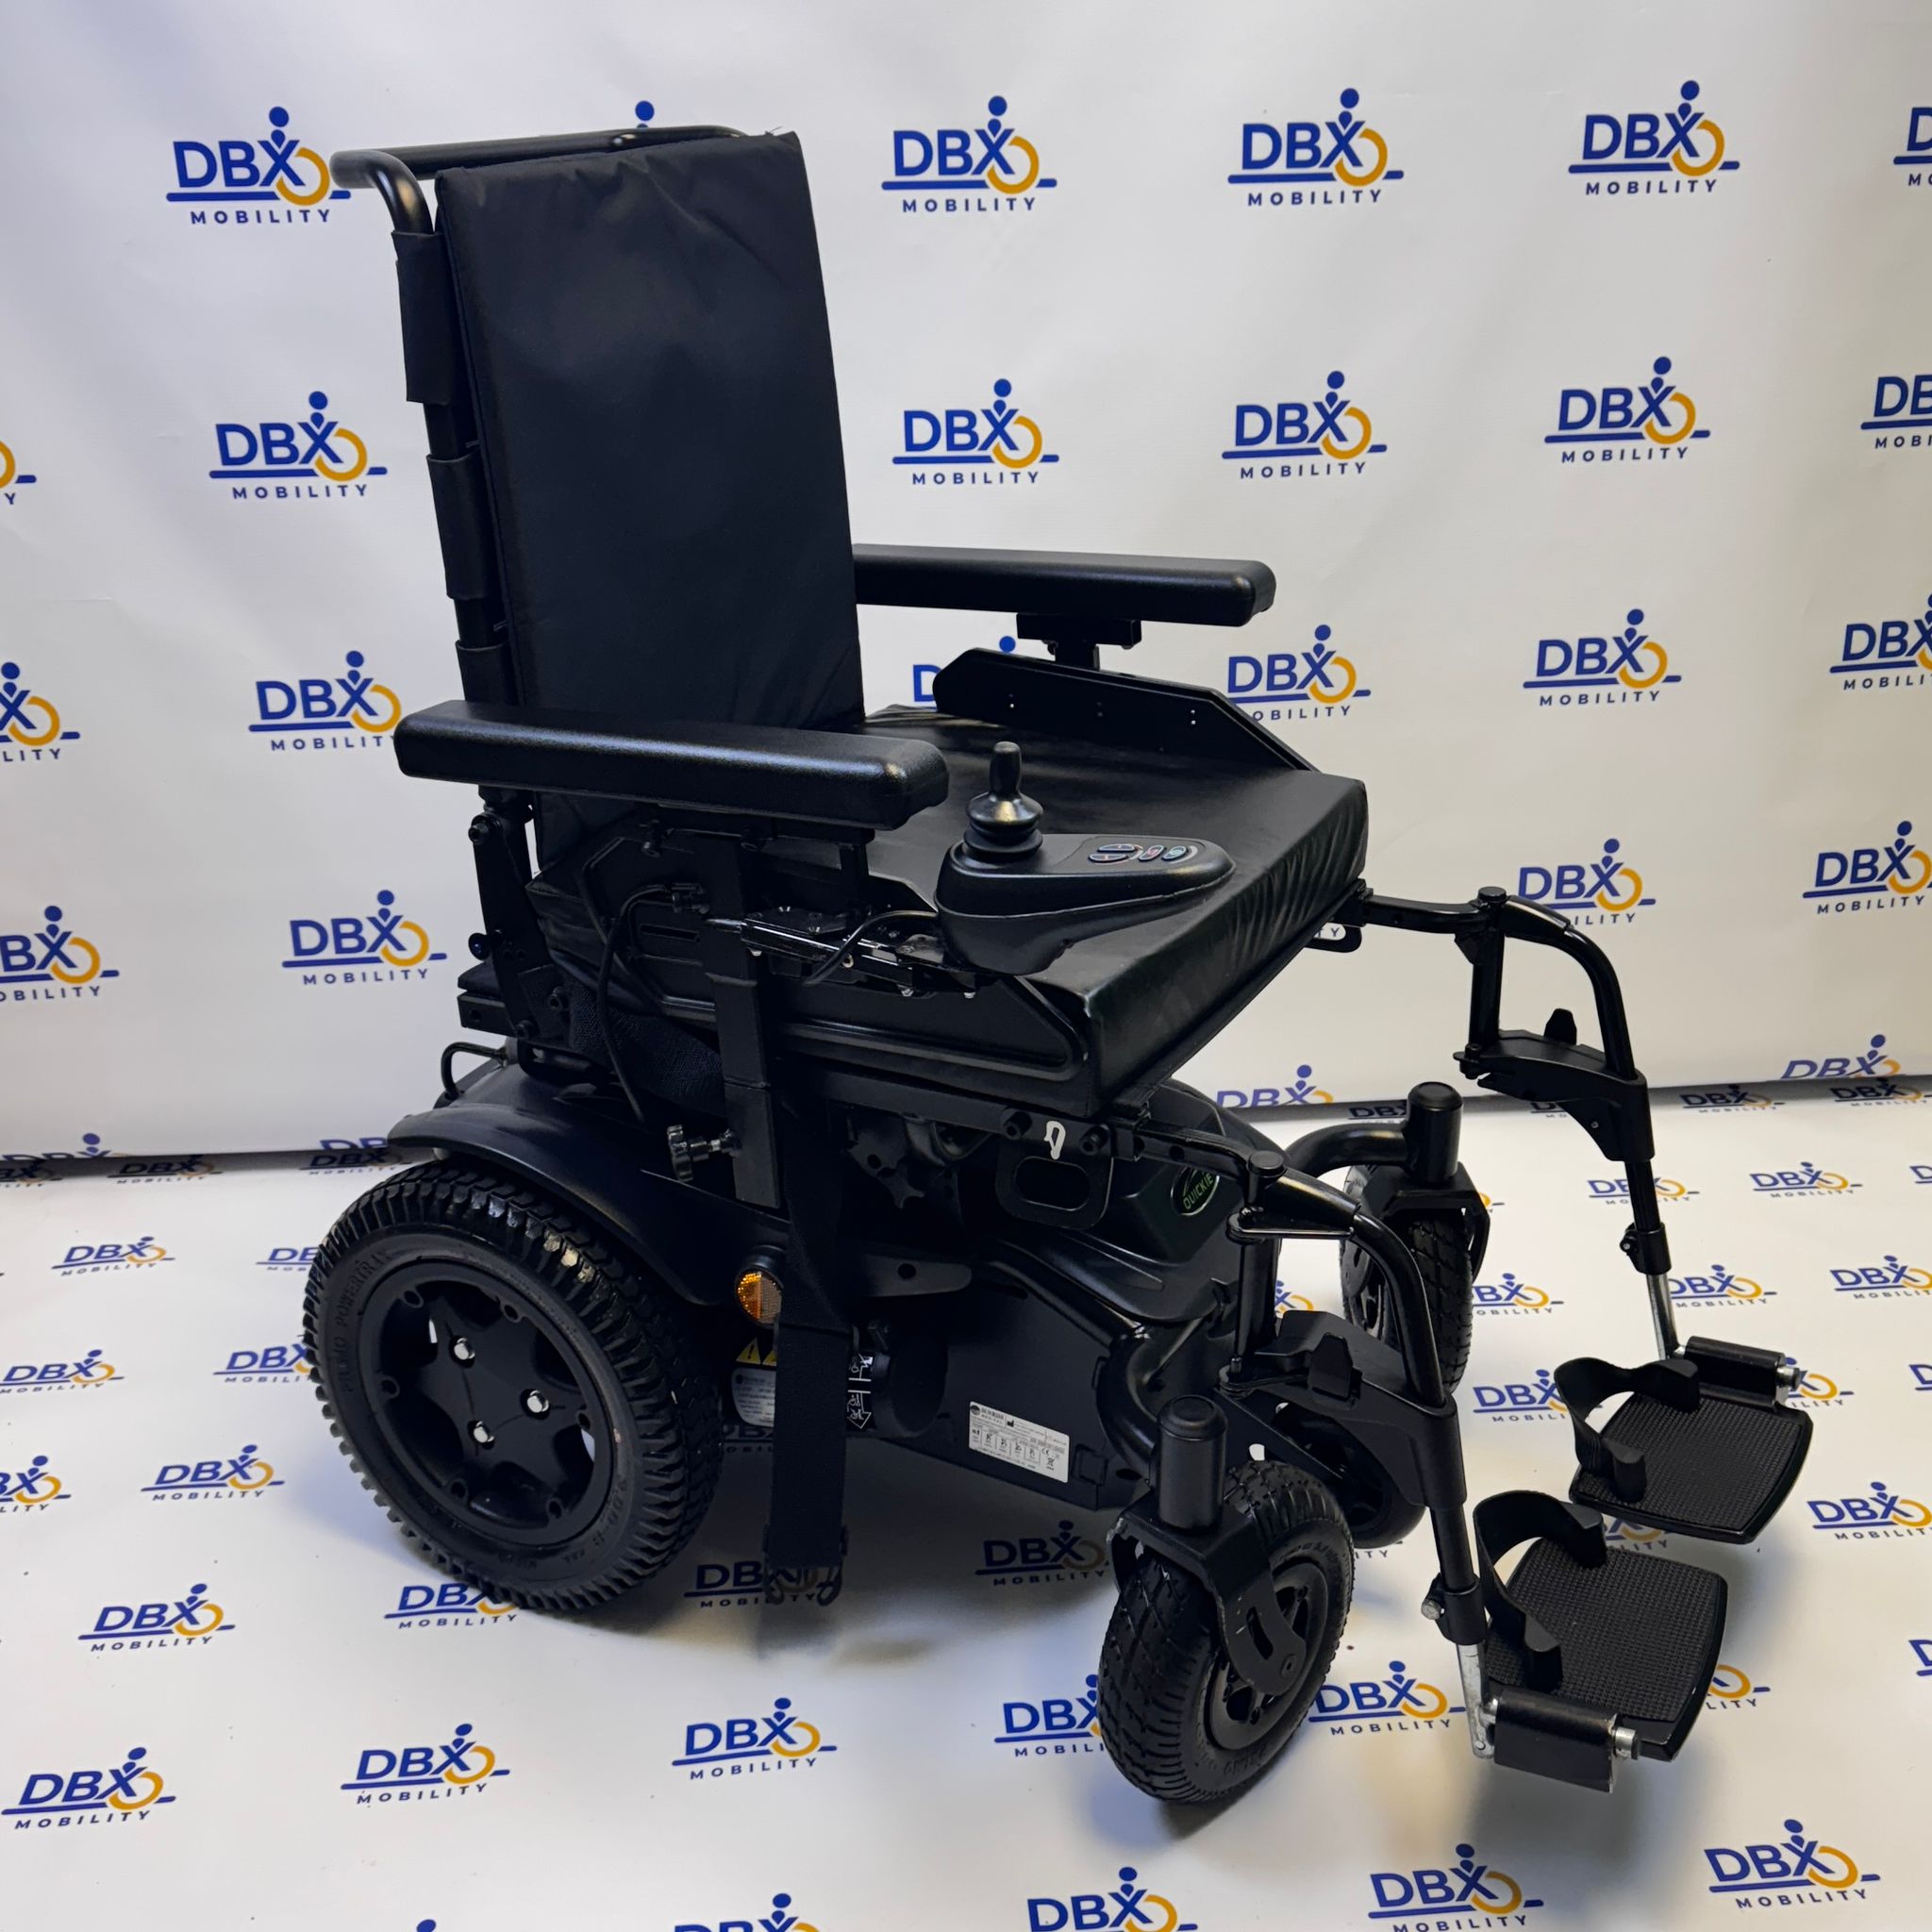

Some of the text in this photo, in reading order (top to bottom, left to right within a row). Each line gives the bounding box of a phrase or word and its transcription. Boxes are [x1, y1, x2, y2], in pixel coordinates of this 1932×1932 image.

[1582, 112, 1704, 158] DBX
[893, 129, 1014, 175] DBX
[1242, 121, 1366, 170] DBX
[173, 140, 306, 188] DBX
[1586, 179, 1717, 195] MOBILITY
[903, 199, 1036, 212] MOBILITY
[1248, 190, 1382, 206] MOBILITY
[191, 208, 331, 225] MOBILITY
[1874, 375, 1932, 417] DB
[1558, 386, 1675, 430] DBX
[904, 409, 1019, 452] DBX
[1235, 401, 1351, 446] DBX
[215, 421, 342, 465] DBX
[1561, 447, 1688, 463] MOBILITY
[912, 472, 1039, 485] MOBILITY
[1240, 462, 1366, 478] MOBILITY
[232, 484, 367, 499] MOBILITY
[1538, 634, 1651, 675] DBX
[1227, 651, 1335, 693] DBX
[257, 676, 378, 720] DBX
[1540, 691, 1659, 707] MOBILITY
[1253, 705, 1352, 722] OBILITY
[271, 736, 396, 751] MOBILIT
[1815, 848, 1914, 889] DBX
[1518, 862, 1624, 899] DBX
[1817, 899, 1925, 914] MOBILITY
[1574, 913, 1635, 924] ILITY
[290, 913, 407, 957] DBX
[0, 931, 77, 972] BX
[303, 969, 429, 985] MOBILITY
[1780, 1056, 1888, 1079] DBX
[1216, 1086, 1317, 1108] DBX
[1680, 1091, 1757, 1106] DBX
[1830, 1085, 1906, 1099] DBX
[120, 1161, 196, 1174] DBX
[1750, 1170, 1833, 1187] DBX
[1183, 1174, 1213, 1208] QUICKIE
[1771, 1190, 1855, 1198] MOBILITY
[64, 1243, 153, 1263] DBX
[61, 1263, 157, 1276] MOBILITY
[1830, 1265, 1921, 1286] DBX
[1474, 1284, 1532, 1302] BX
[1676, 1299, 1767, 1307] MOBILITY
[3, 1361, 102, 1381] DBX
[1492, 1413, 1565, 1422] MOBILI
[155, 1458, 259, 1485] DBX
[152, 1490, 264, 1501] MOBILITY
[1807, 1495, 1914, 1523] DBX
[1835, 1527, 1925, 1540] MOBILIT
[983, 1537, 1084, 1566] DBX
[993, 1572, 1105, 1586] MOBILITY
[93, 1597, 208, 1632] DBX
[398, 1615, 516, 1628] MOBILITY
[91, 1637, 213, 1653] MOBILITY
[1314, 1678, 1425, 1713] DBX
[684, 1714, 799, 1755] DBX
[1331, 1719, 1451, 1736] MOBILITY
[1015, 1743, 1104, 1757] MOBILI
[356, 1740, 475, 1781] DBX
[690, 1758, 817, 1781] MOBILITY
[21, 1764, 148, 1805] DBX
[357, 1783, 488, 1805] MOBILITY
[15, 1810, 151, 1829] MOBILITY
[1705, 1840, 1836, 1882] DBX
[1370, 1865, 1498, 1907] DBX
[1735, 1889, 1868, 1909] MOBILITY
[1027, 1889, 1152, 1931] DBX
